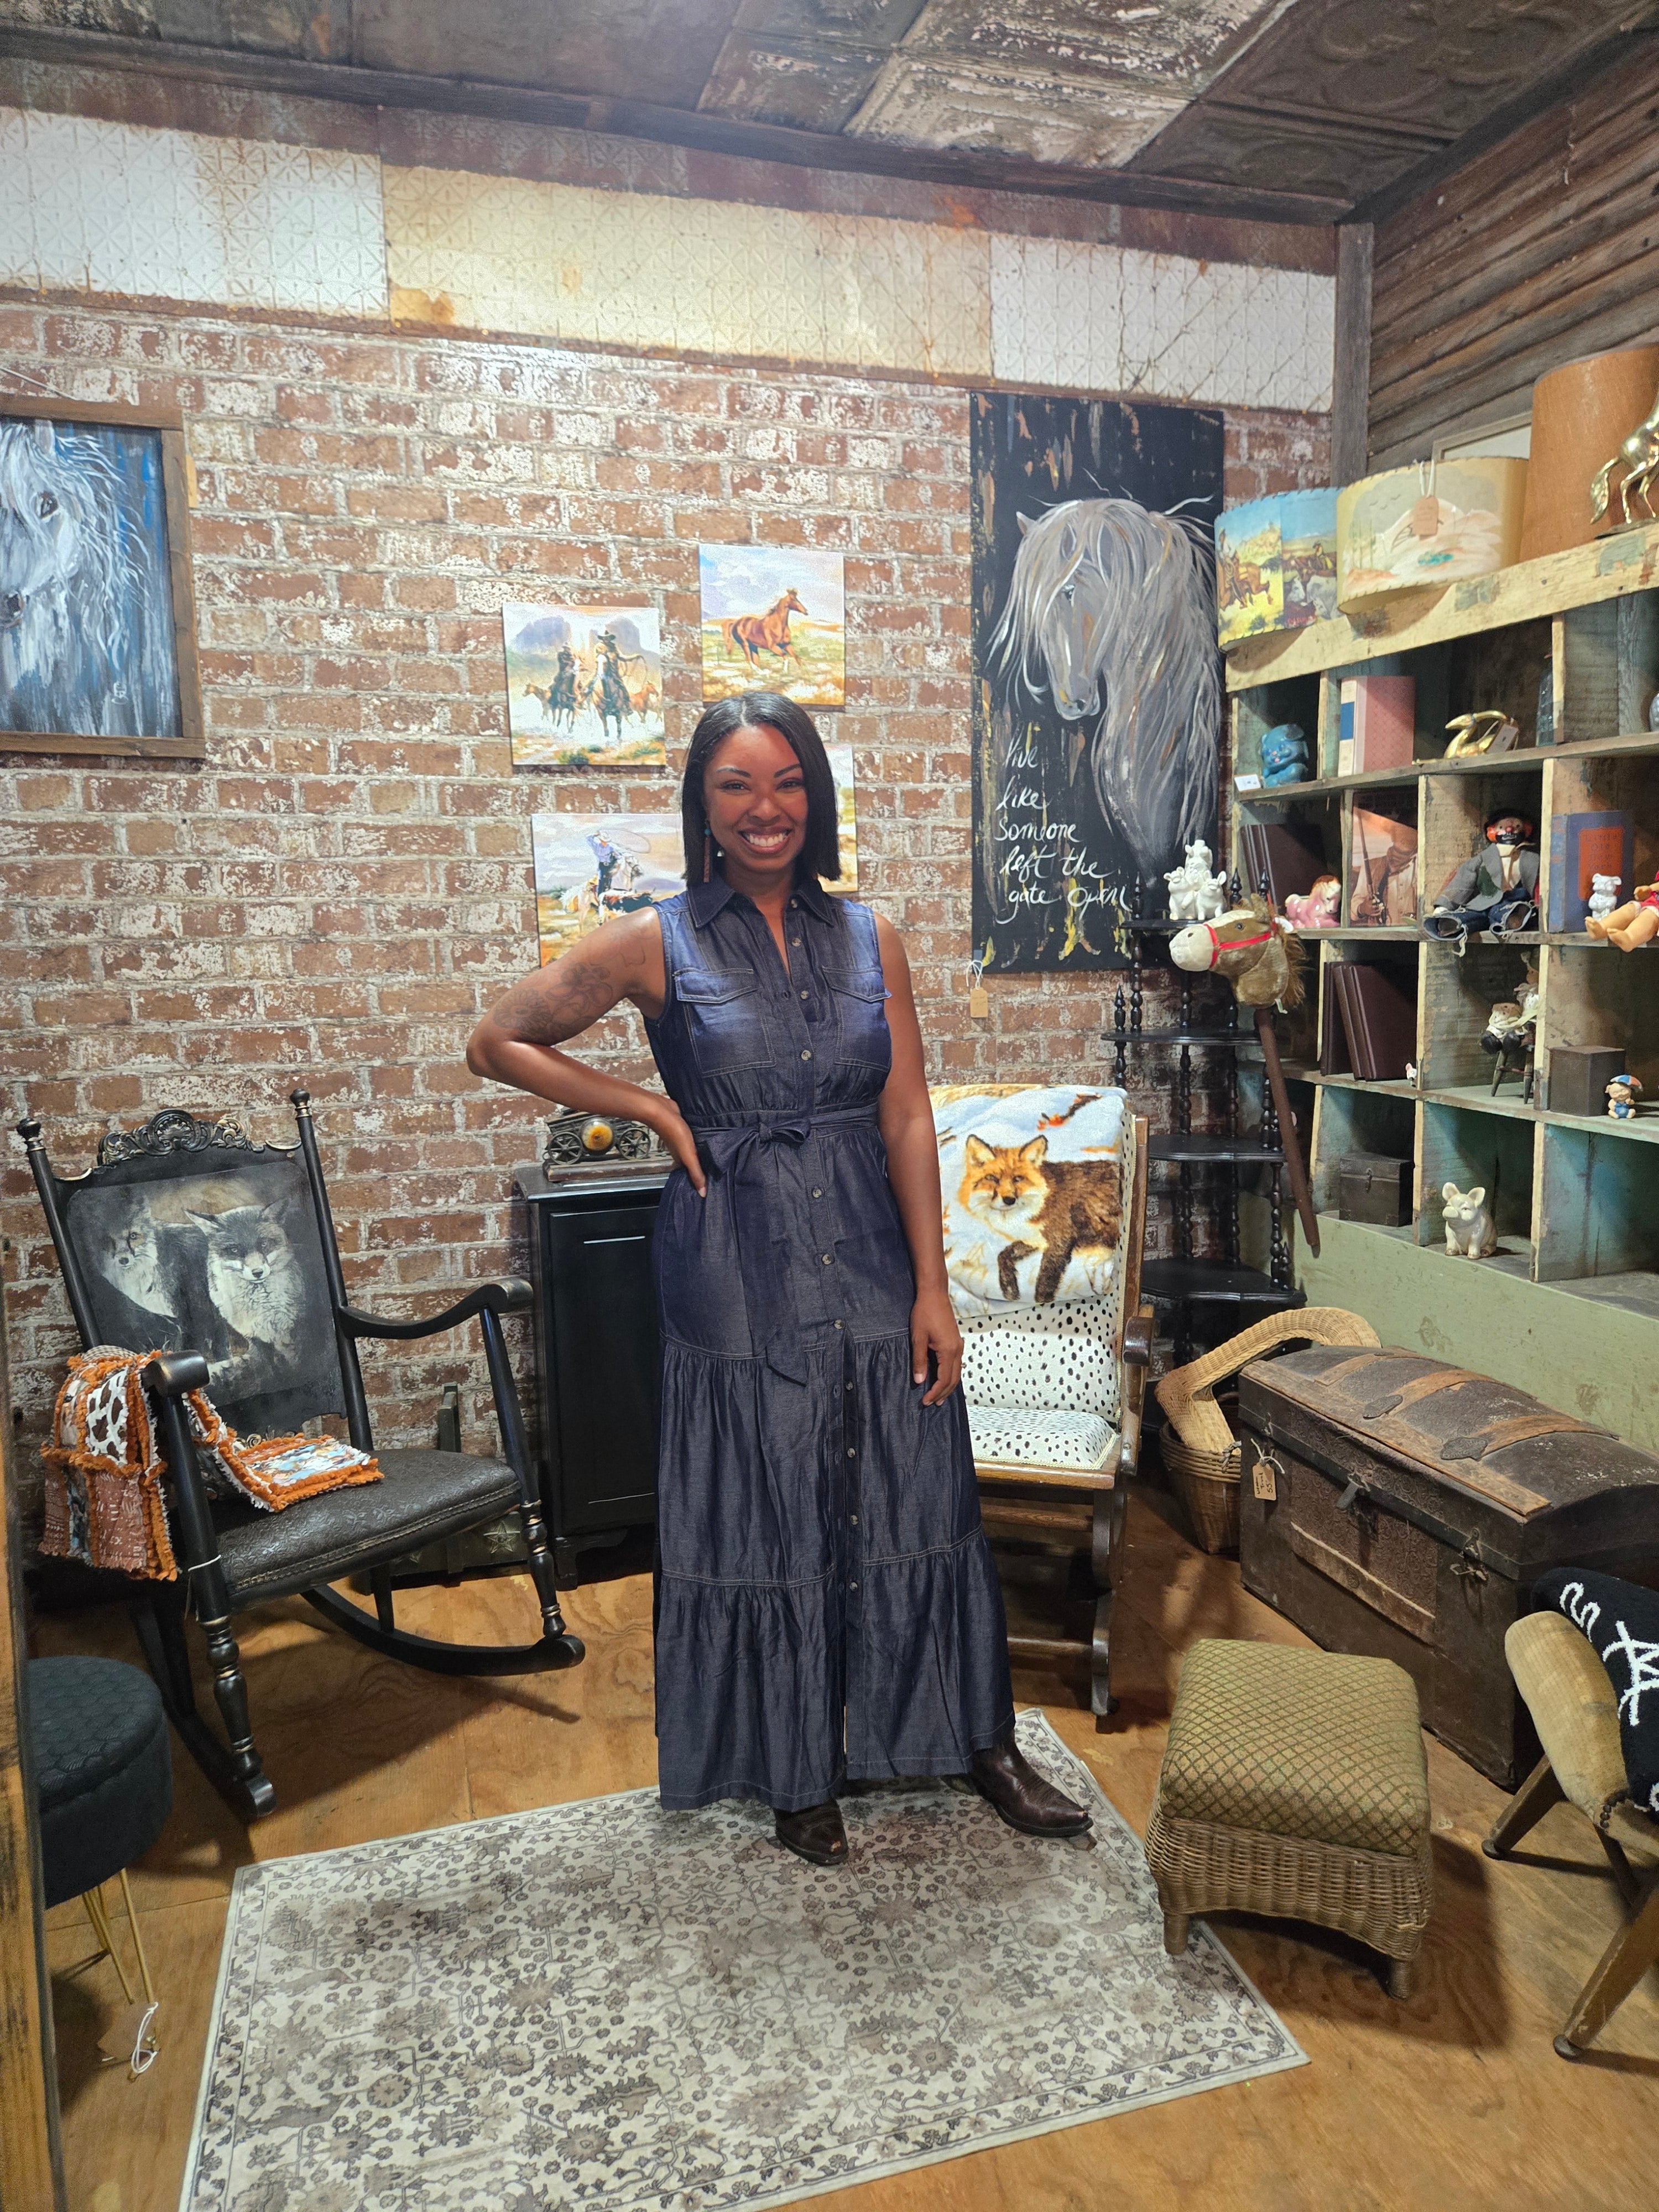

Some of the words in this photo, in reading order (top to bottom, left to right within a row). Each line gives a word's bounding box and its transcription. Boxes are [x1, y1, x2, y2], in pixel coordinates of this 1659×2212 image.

[1000, 845, 1057, 883] left
[1060, 846, 1119, 879] the
[995, 882, 1061, 924] gate
